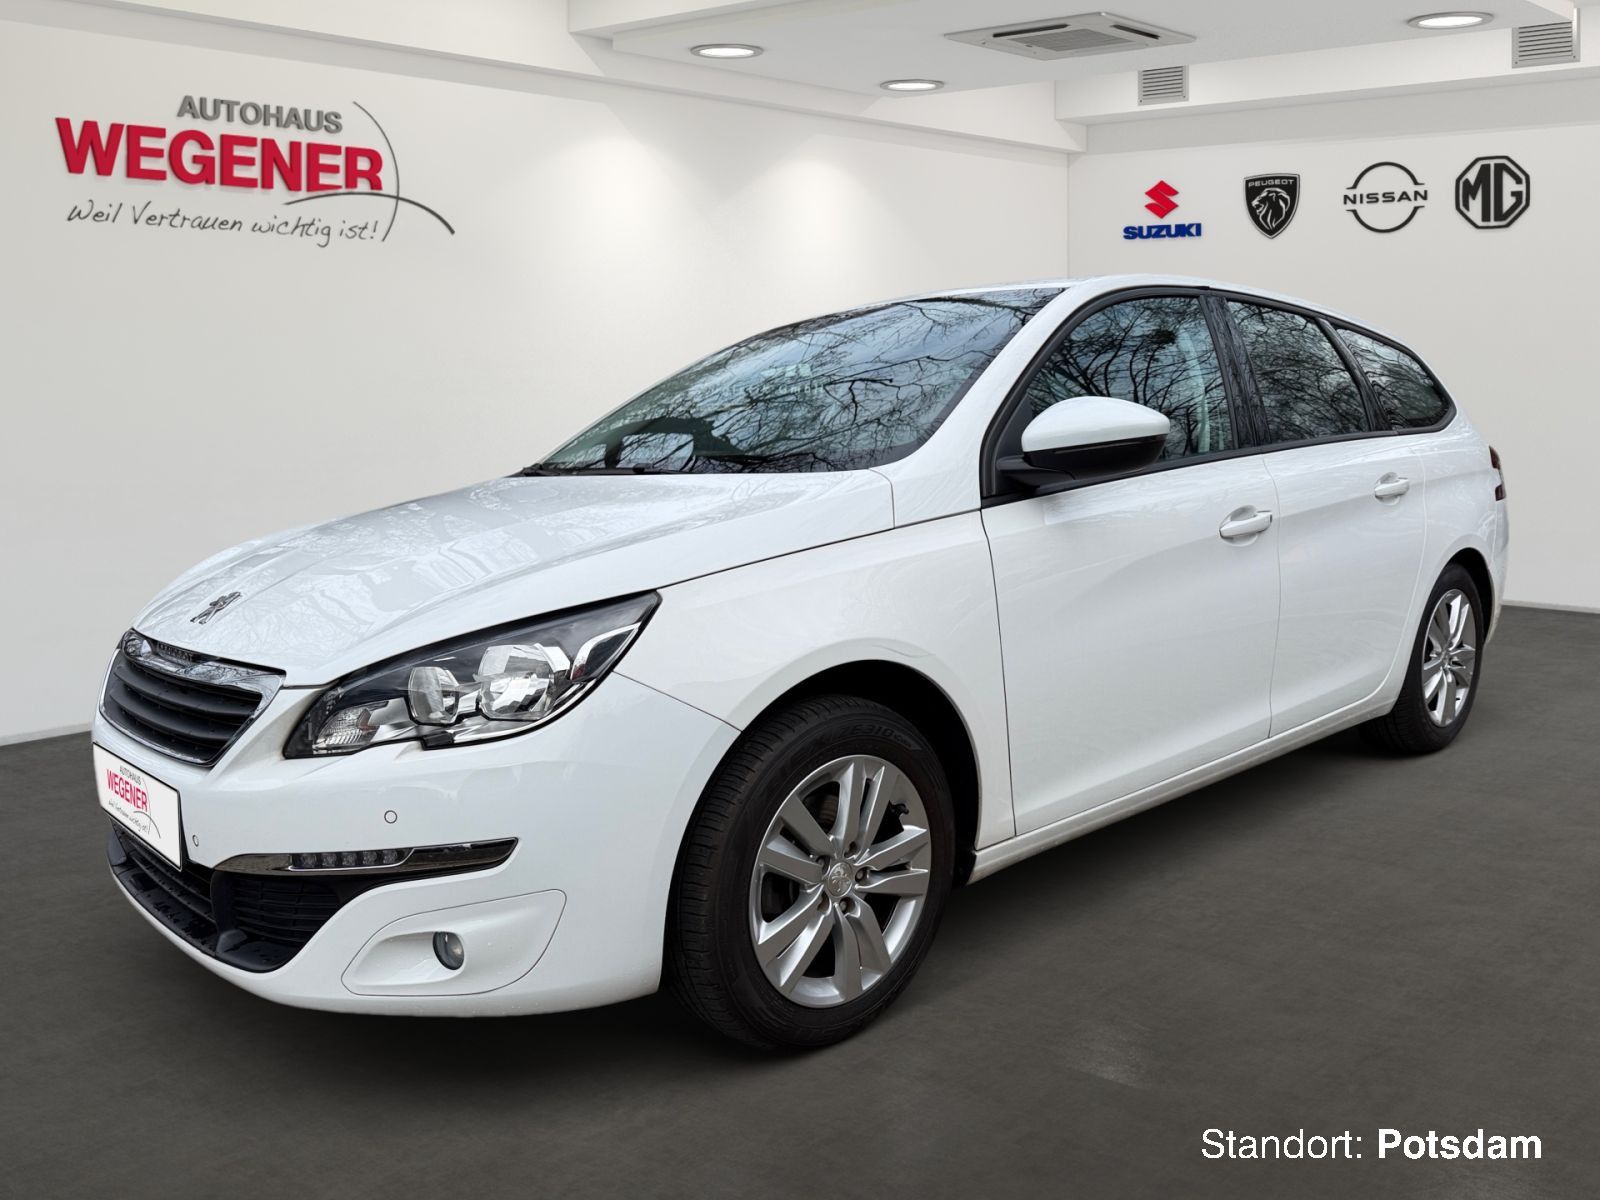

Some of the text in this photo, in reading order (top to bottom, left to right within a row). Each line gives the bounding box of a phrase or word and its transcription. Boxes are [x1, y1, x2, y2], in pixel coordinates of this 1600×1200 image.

[177, 95, 343, 134] AUTOHAUS
[55, 116, 384, 193] WEGENER
[1248, 178, 1295, 188] PEUGEOT
[1343, 189, 1428, 206] NISSAN
[1462, 162, 1524, 223] MG
[67, 199, 379, 248] Weil Vertrauen wichtig ist!
[1123, 222, 1202, 240] SUZUKI
[106, 768, 148, 812] WEGENER
